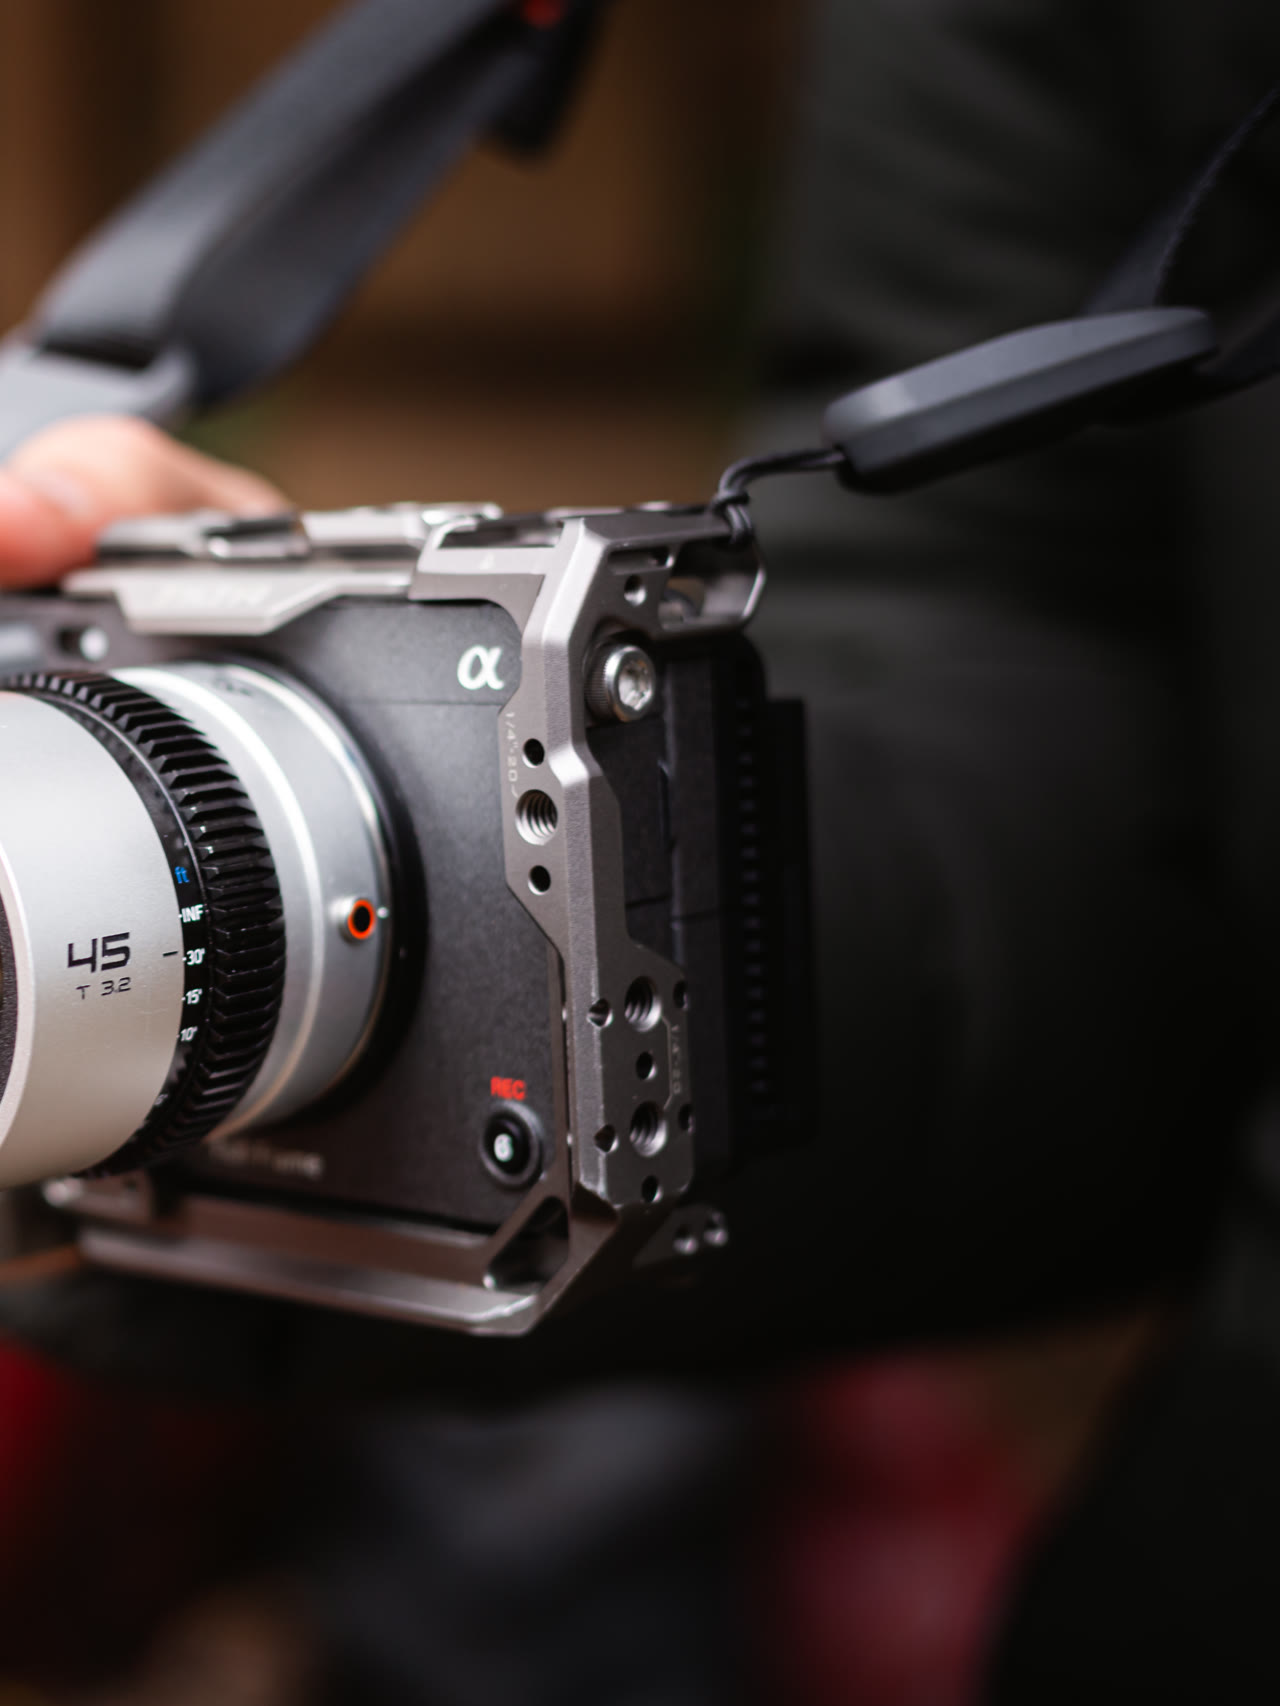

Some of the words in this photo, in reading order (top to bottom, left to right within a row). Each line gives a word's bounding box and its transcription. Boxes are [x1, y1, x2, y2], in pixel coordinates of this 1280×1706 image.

[174, 866, 189, 884] ft
[181, 904, 204, 923] INF
[67, 932, 130, 973] 45
[76, 984, 91, 1000] T
[100, 976, 131, 996] 3.2
[490, 1076, 526, 1100] REC
